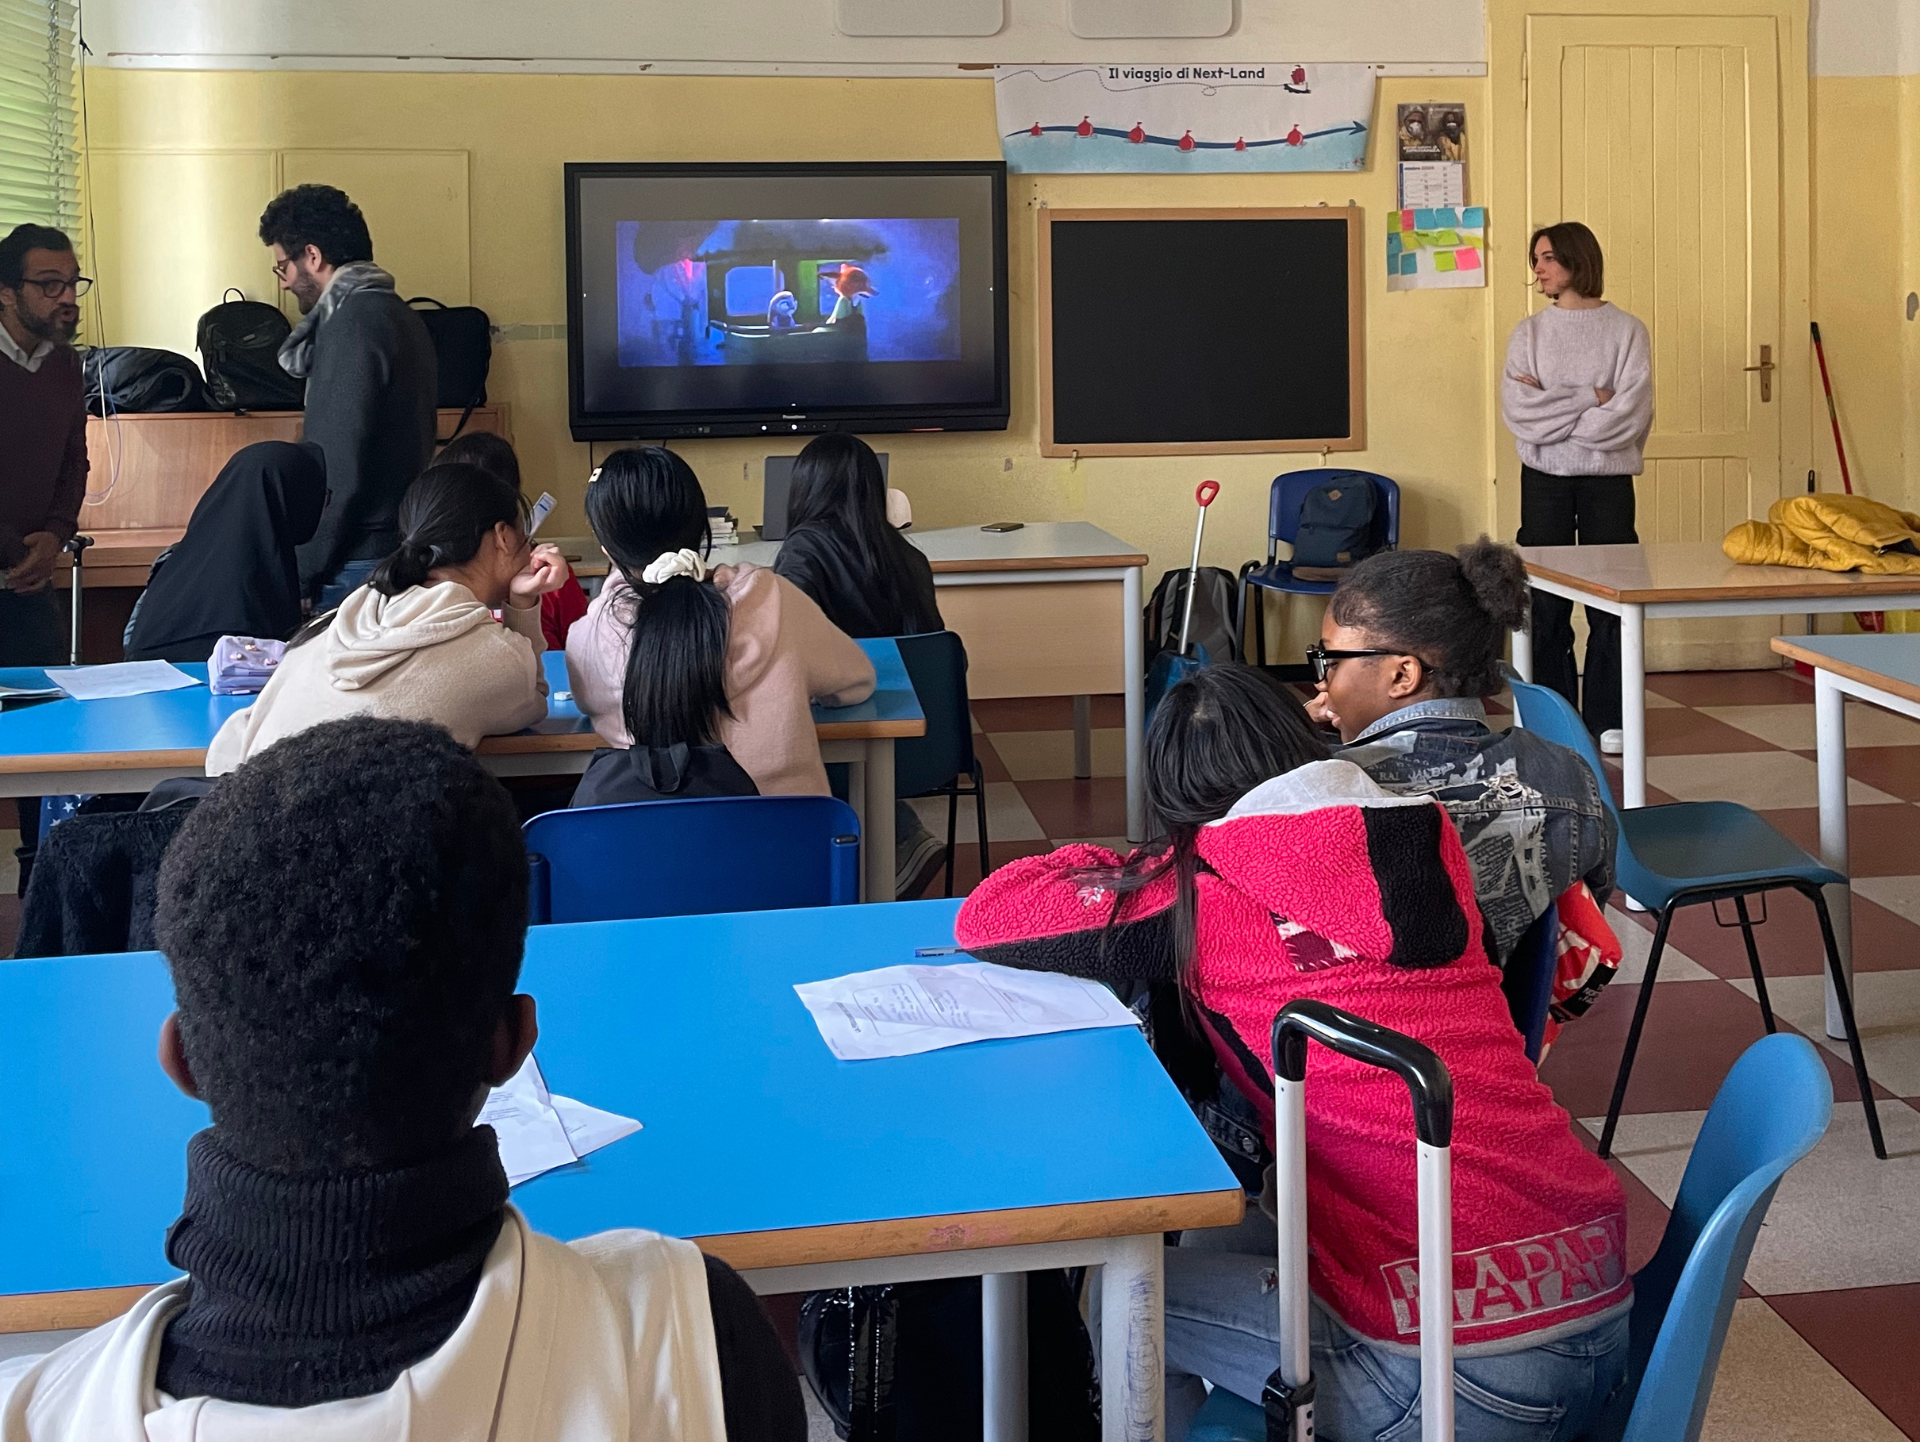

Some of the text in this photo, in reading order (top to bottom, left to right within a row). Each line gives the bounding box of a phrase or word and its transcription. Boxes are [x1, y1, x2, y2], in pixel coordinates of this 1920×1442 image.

[1108, 67, 1265, 82] Il viaggio di Next-Land
